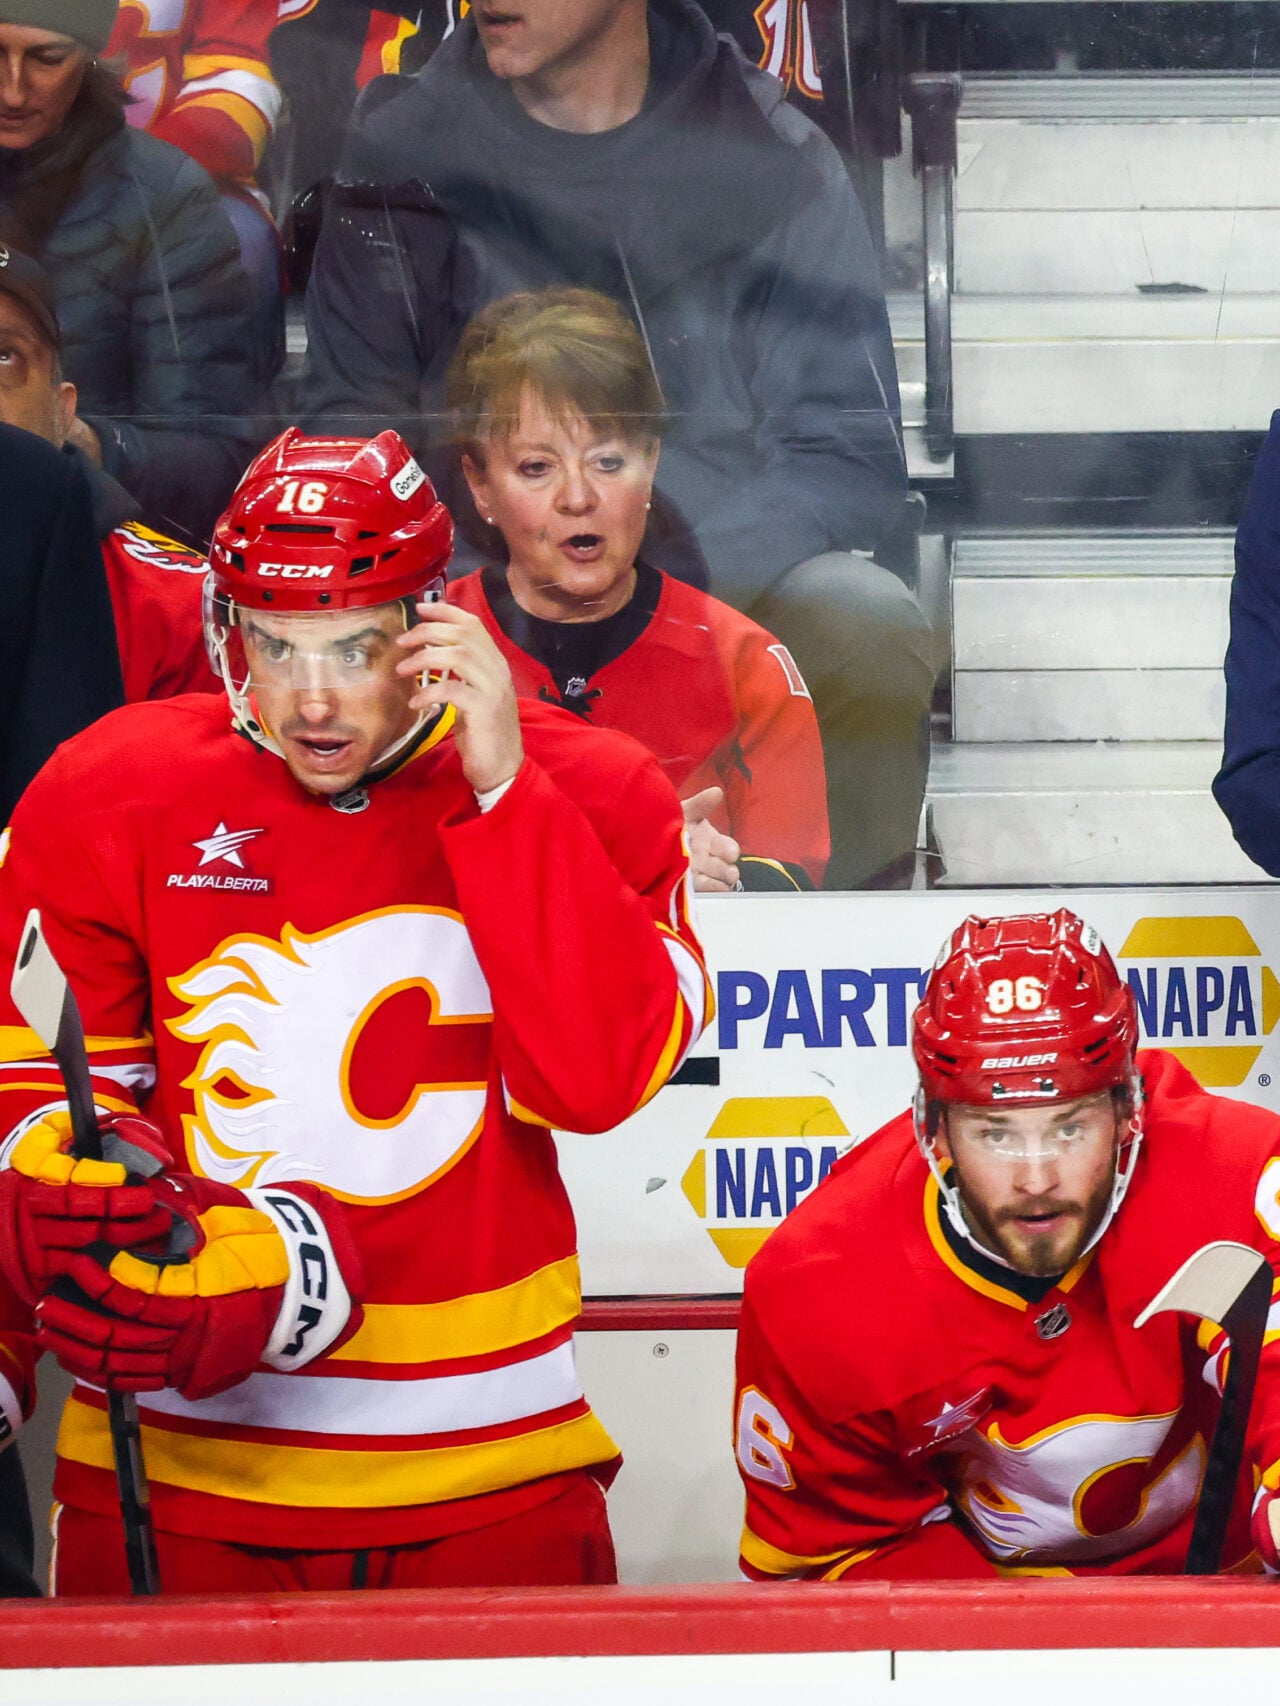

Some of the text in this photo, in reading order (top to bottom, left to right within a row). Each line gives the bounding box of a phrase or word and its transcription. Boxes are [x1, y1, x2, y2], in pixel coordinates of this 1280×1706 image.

[277, 482, 329, 513] 16
[257, 562, 335, 578] CCM
[166, 874, 268, 892] PLAYALBERTA
[717, 968, 933, 1049] PART
[988, 977, 1042, 1014] 86
[1127, 966, 1257, 1037] NAPA
[264, 1196, 328, 1356] CCM
